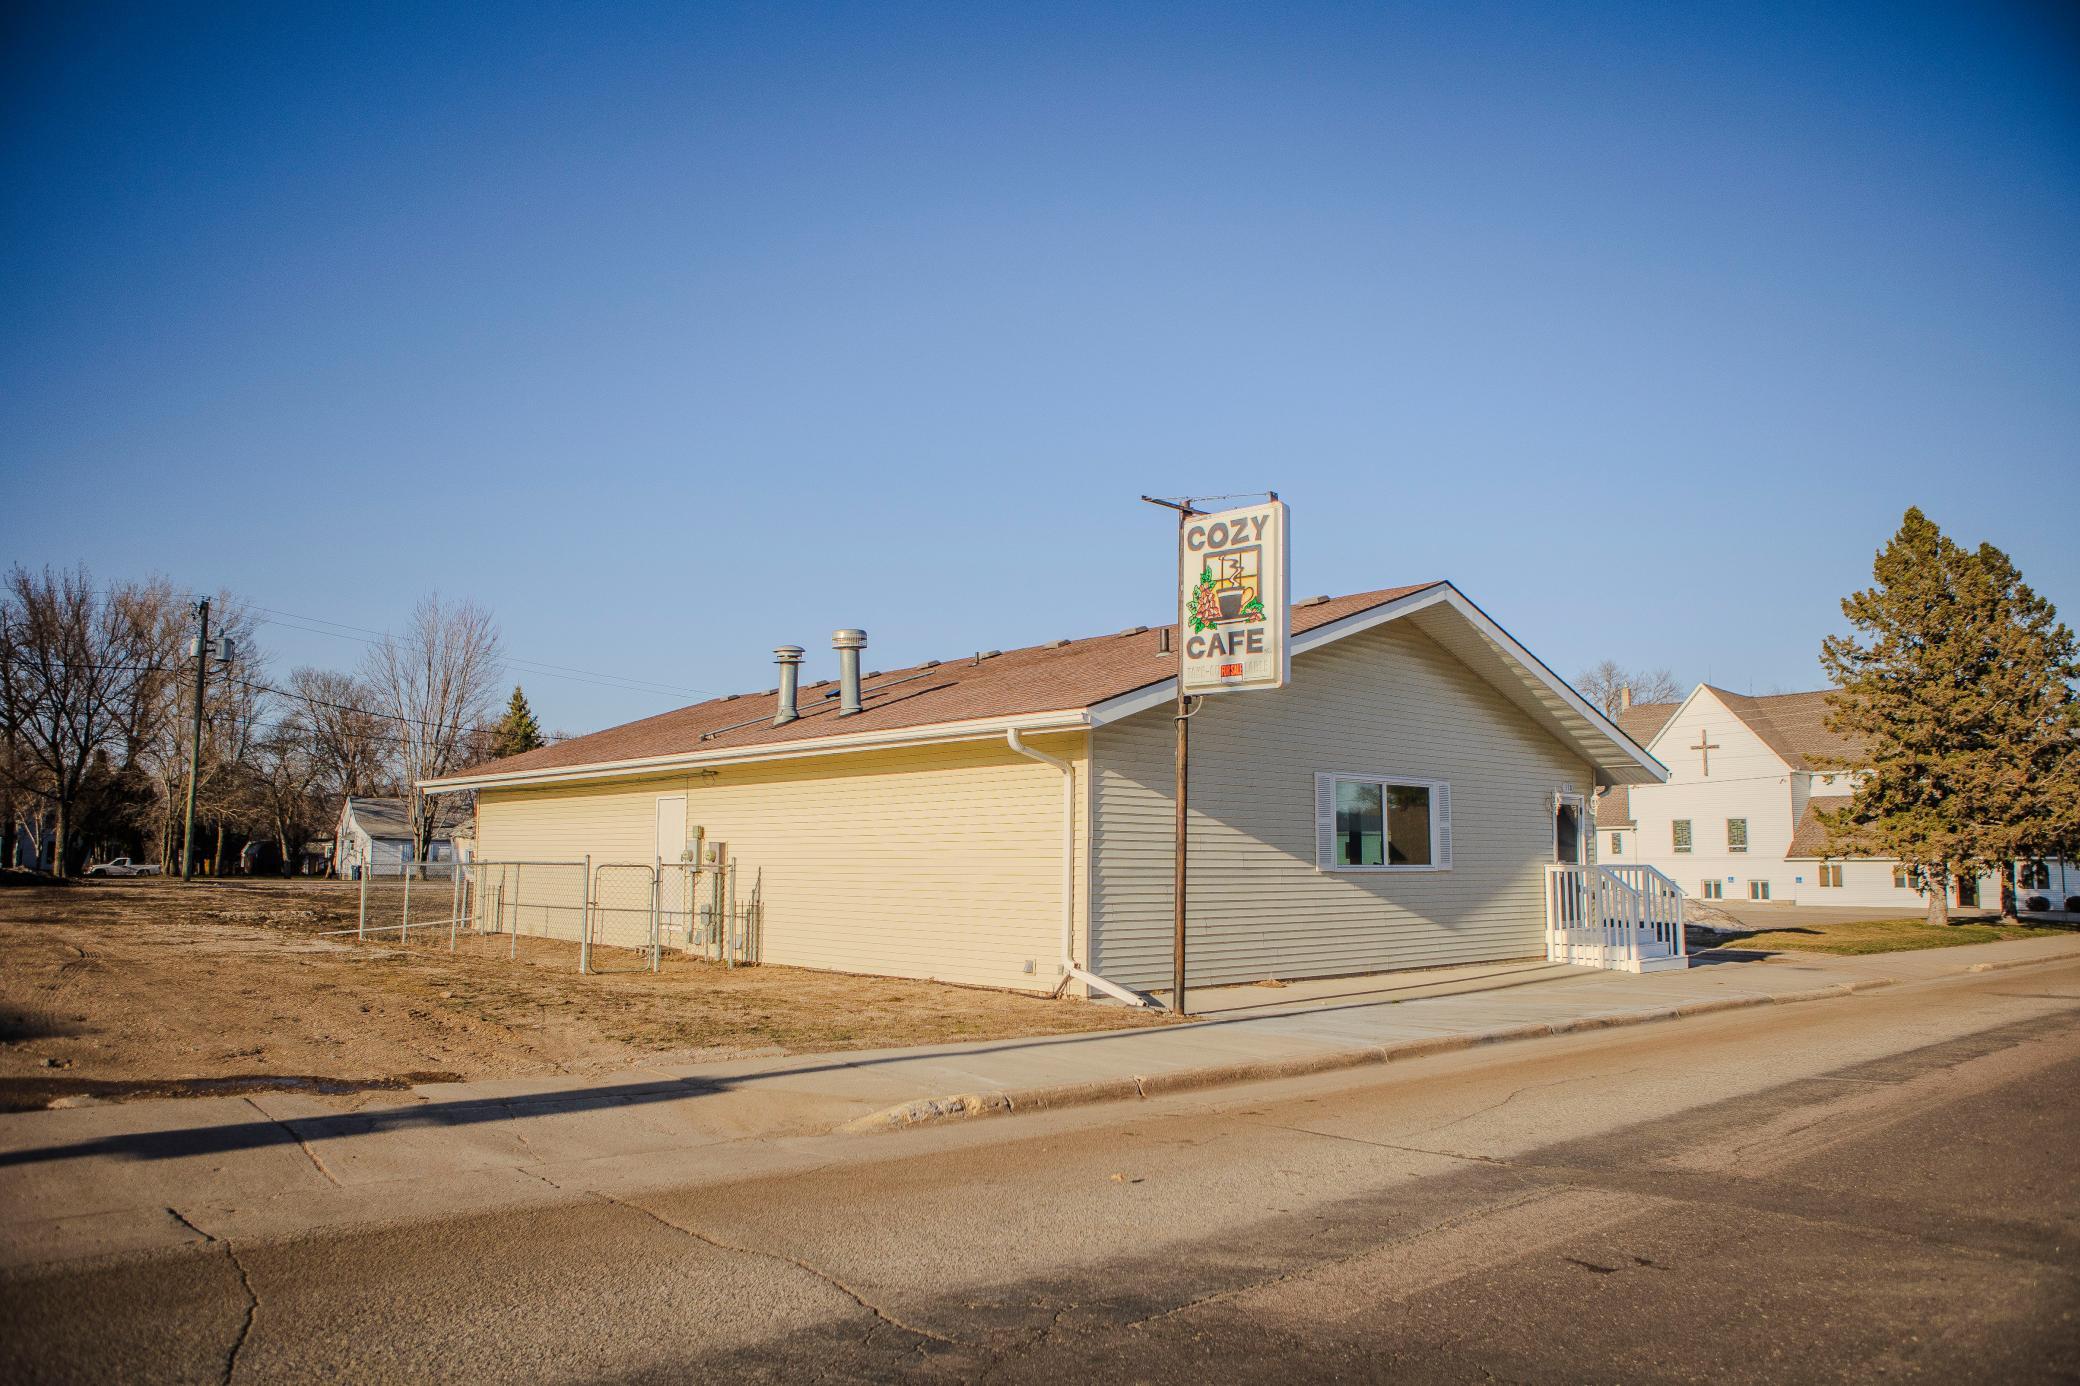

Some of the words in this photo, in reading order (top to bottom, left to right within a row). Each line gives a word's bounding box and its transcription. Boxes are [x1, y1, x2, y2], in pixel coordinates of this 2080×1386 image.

[1188, 515, 1269, 551] COZY
[1187, 628, 1264, 659] CAFE
[1222, 665, 1231, 676] FOR
[1231, 664, 1242, 675] SALE
